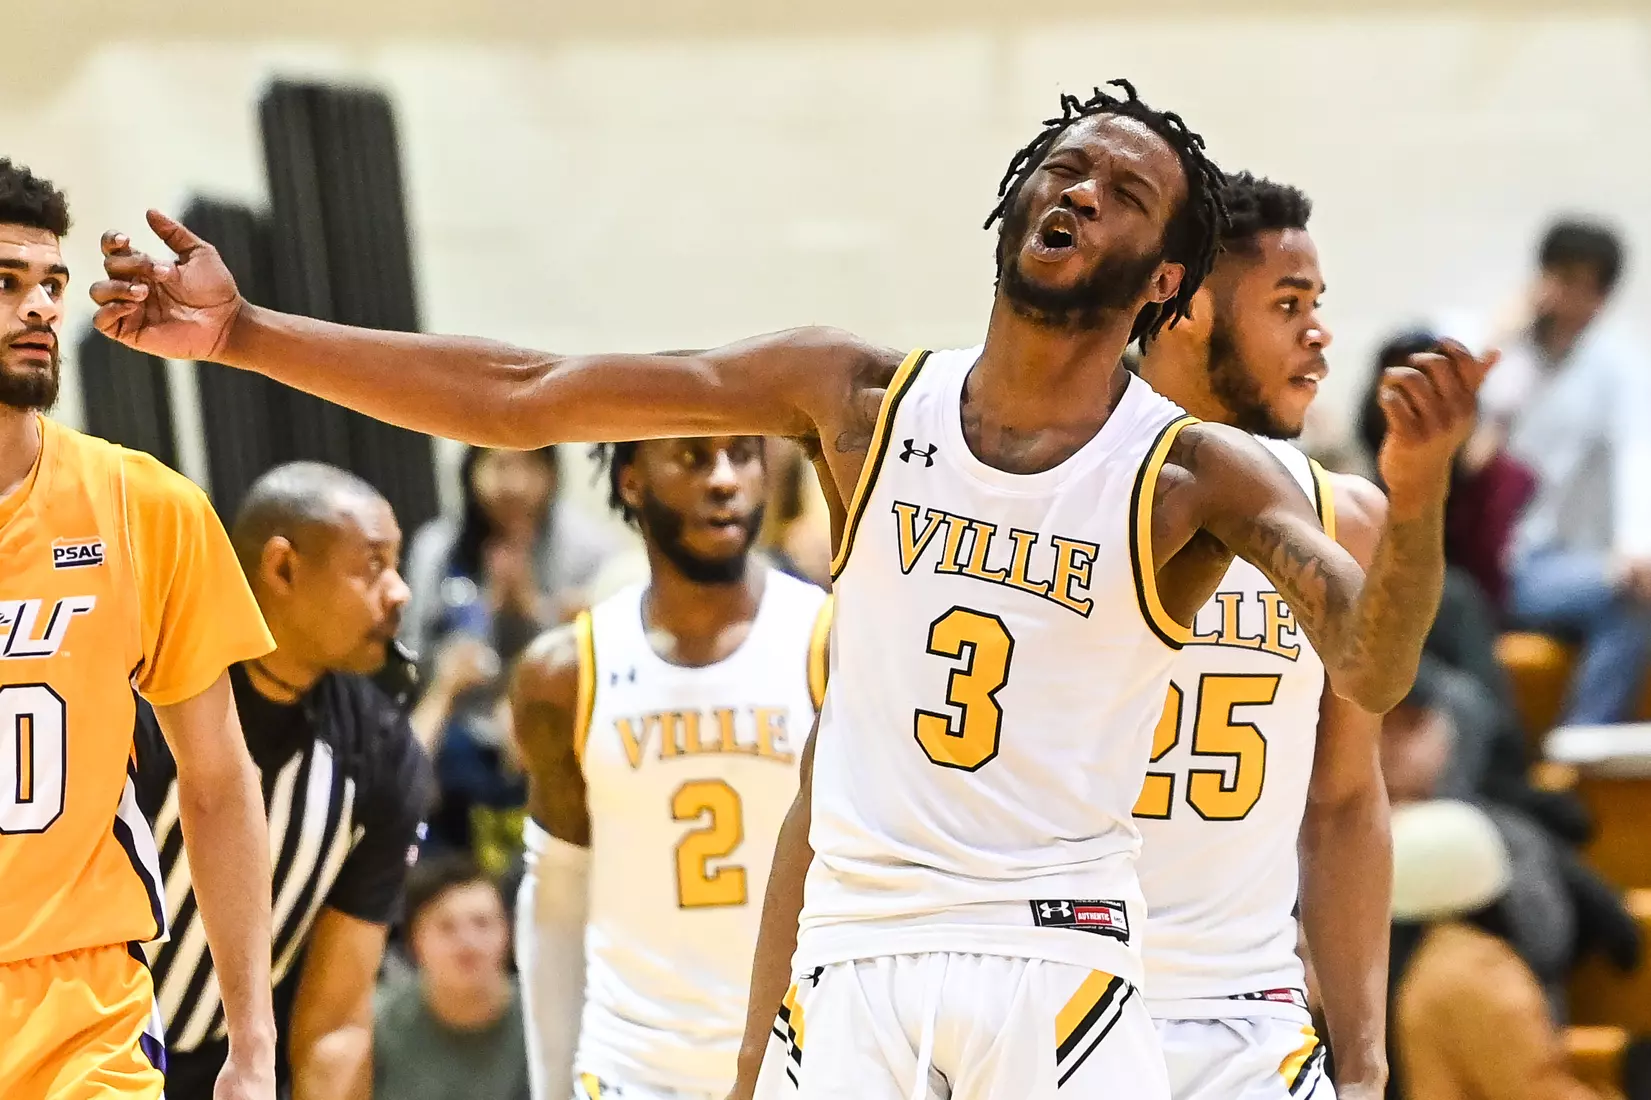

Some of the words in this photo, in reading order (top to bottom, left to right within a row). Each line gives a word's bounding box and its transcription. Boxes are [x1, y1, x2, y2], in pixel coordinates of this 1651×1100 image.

[53, 543, 103, 561] PSAC
[891, 500, 1100, 619] VILLE
[614, 706, 795, 770] VILLE
[913, 605, 1015, 773] 3
[1131, 672, 1283, 821] 25
[671, 778, 748, 910] 2
